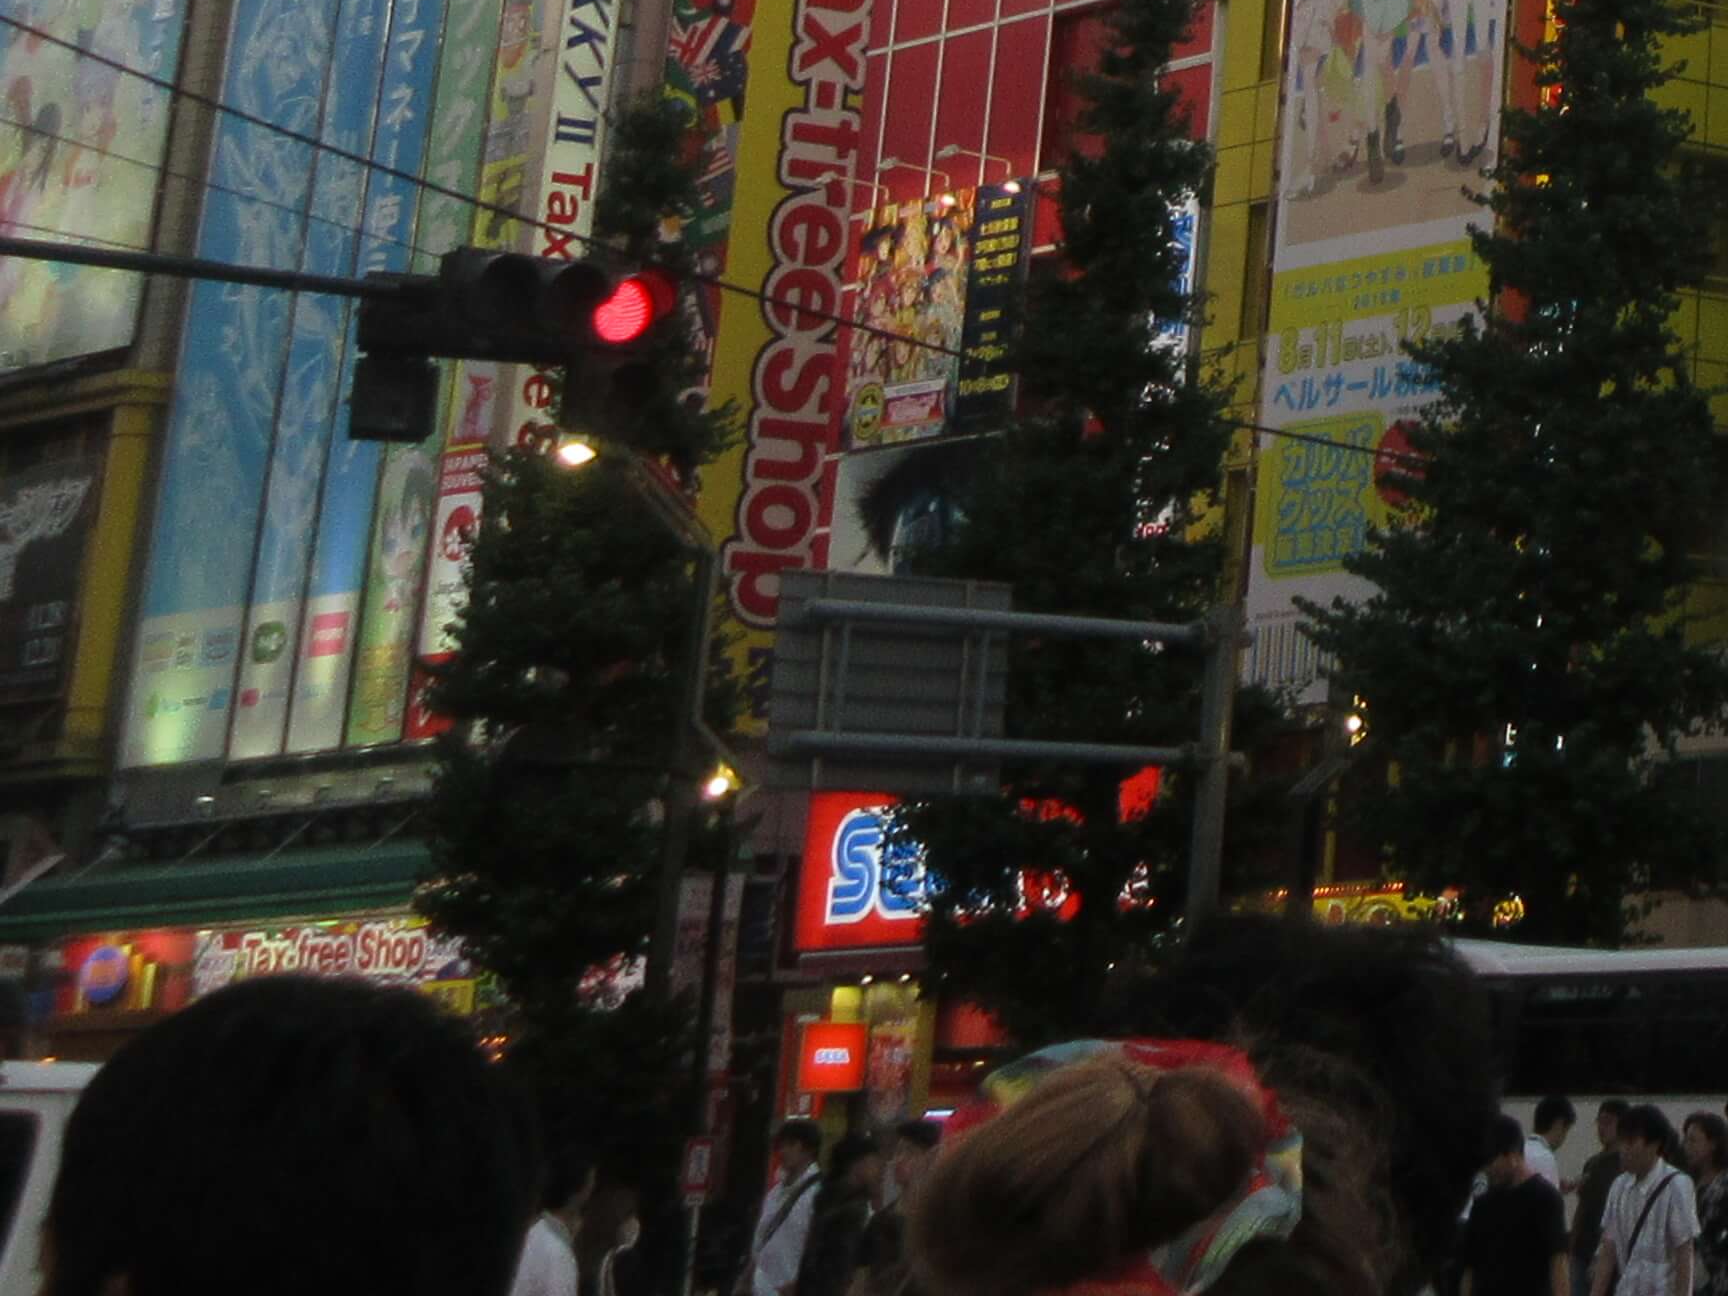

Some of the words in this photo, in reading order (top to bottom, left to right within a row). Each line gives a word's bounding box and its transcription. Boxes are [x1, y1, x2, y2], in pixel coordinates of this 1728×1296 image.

[554, 111, 597, 146] II
[541, 161, 595, 260] Tax
[729, 344, 836, 621] Shop
[357, 926, 425, 971] Shop
